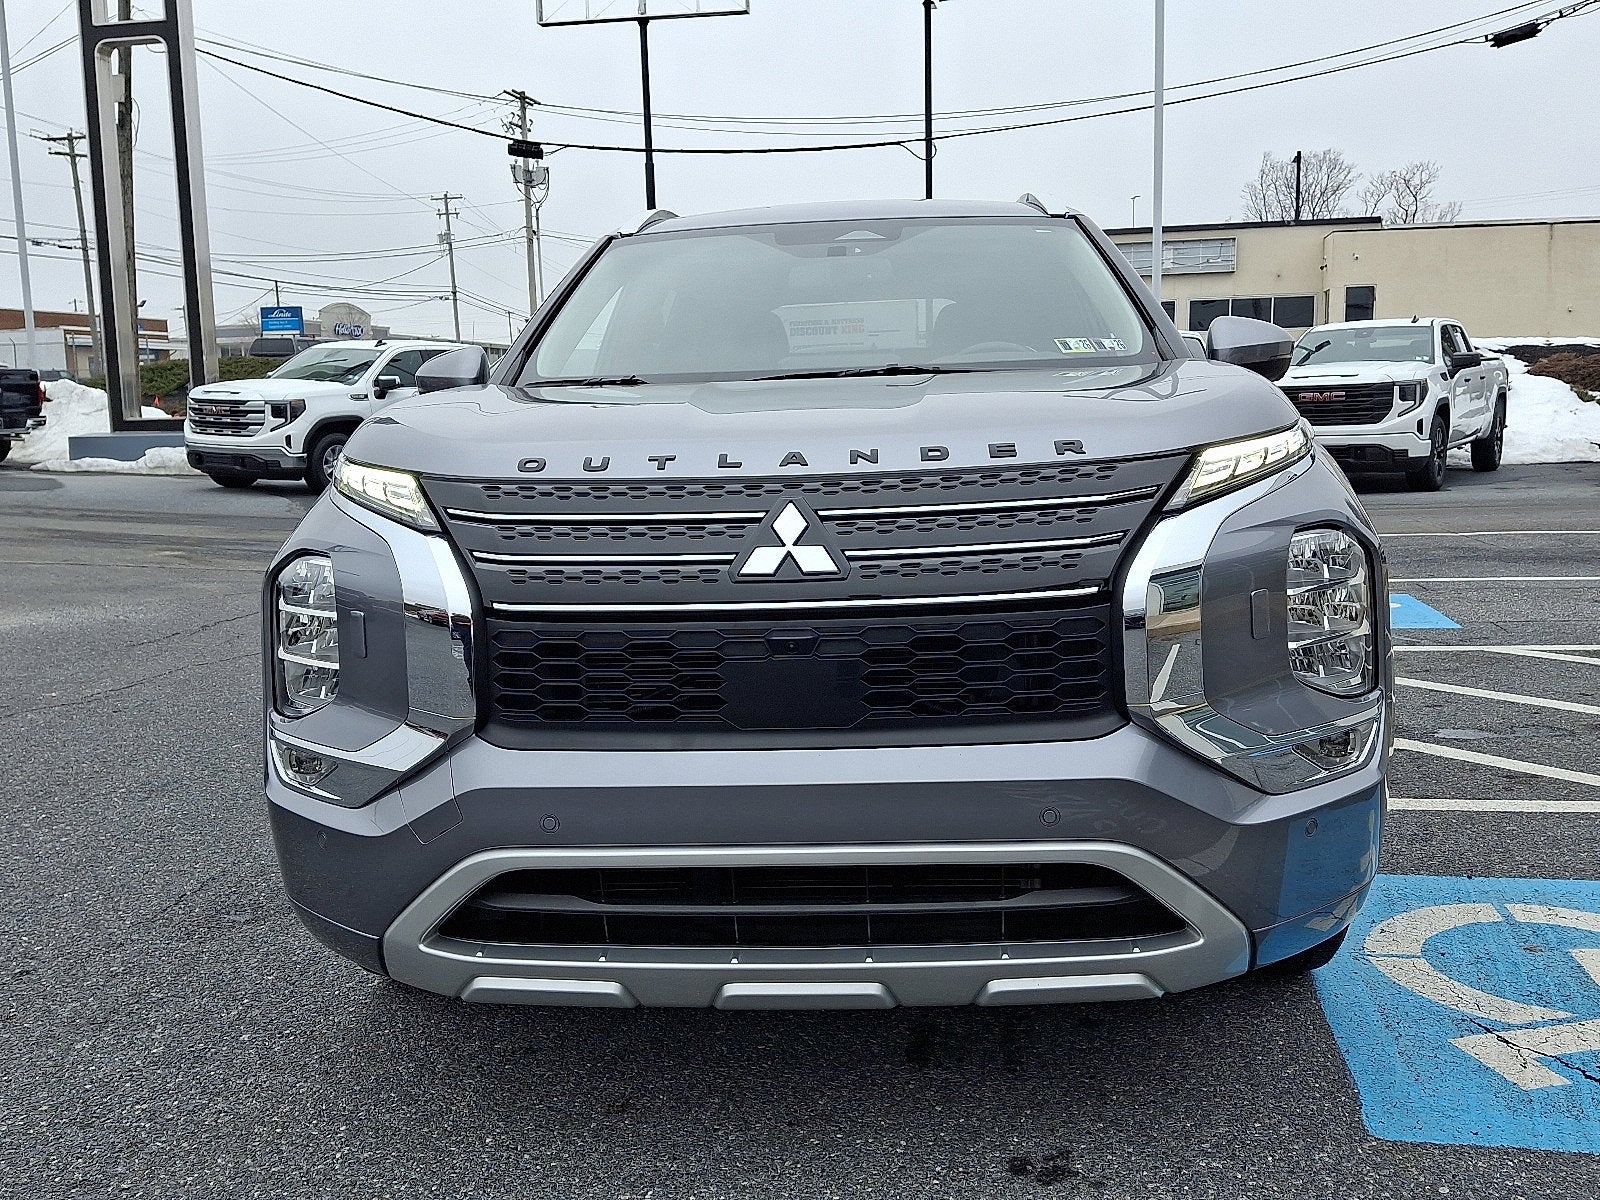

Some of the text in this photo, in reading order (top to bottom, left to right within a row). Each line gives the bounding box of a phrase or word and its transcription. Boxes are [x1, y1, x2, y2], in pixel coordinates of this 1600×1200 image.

[789, 326, 838, 337] DISCOUNT
[1299, 391, 1346, 402] GMC
[517, 439, 1087, 473] OUTLANDER
